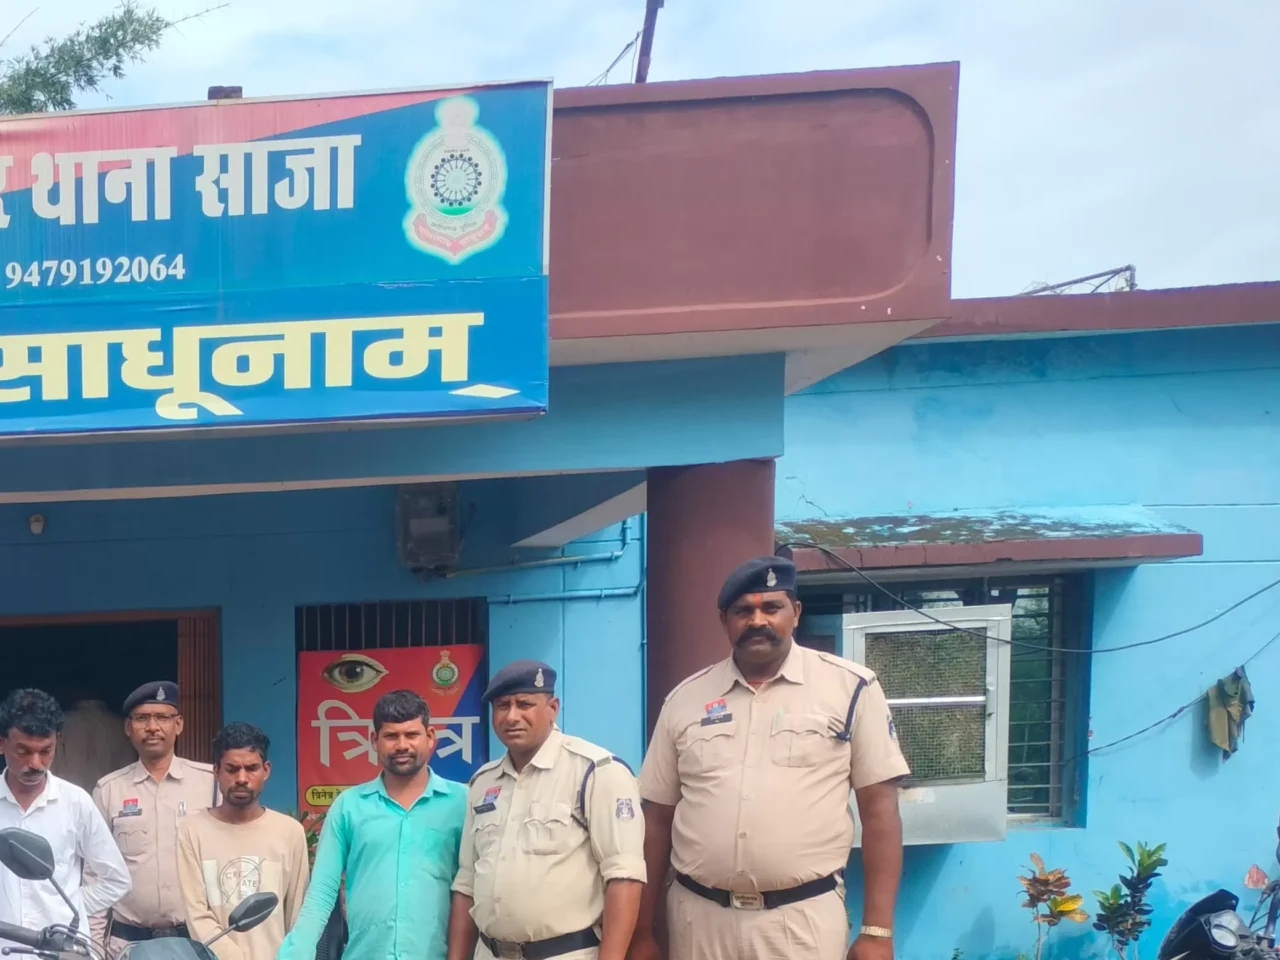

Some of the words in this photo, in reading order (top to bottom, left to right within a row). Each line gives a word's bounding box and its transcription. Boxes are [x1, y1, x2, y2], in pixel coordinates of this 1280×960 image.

[31, 147, 178, 226] थाना
[193, 135, 361, 218] साजा
[5, 254, 186, 289] 9479192064
